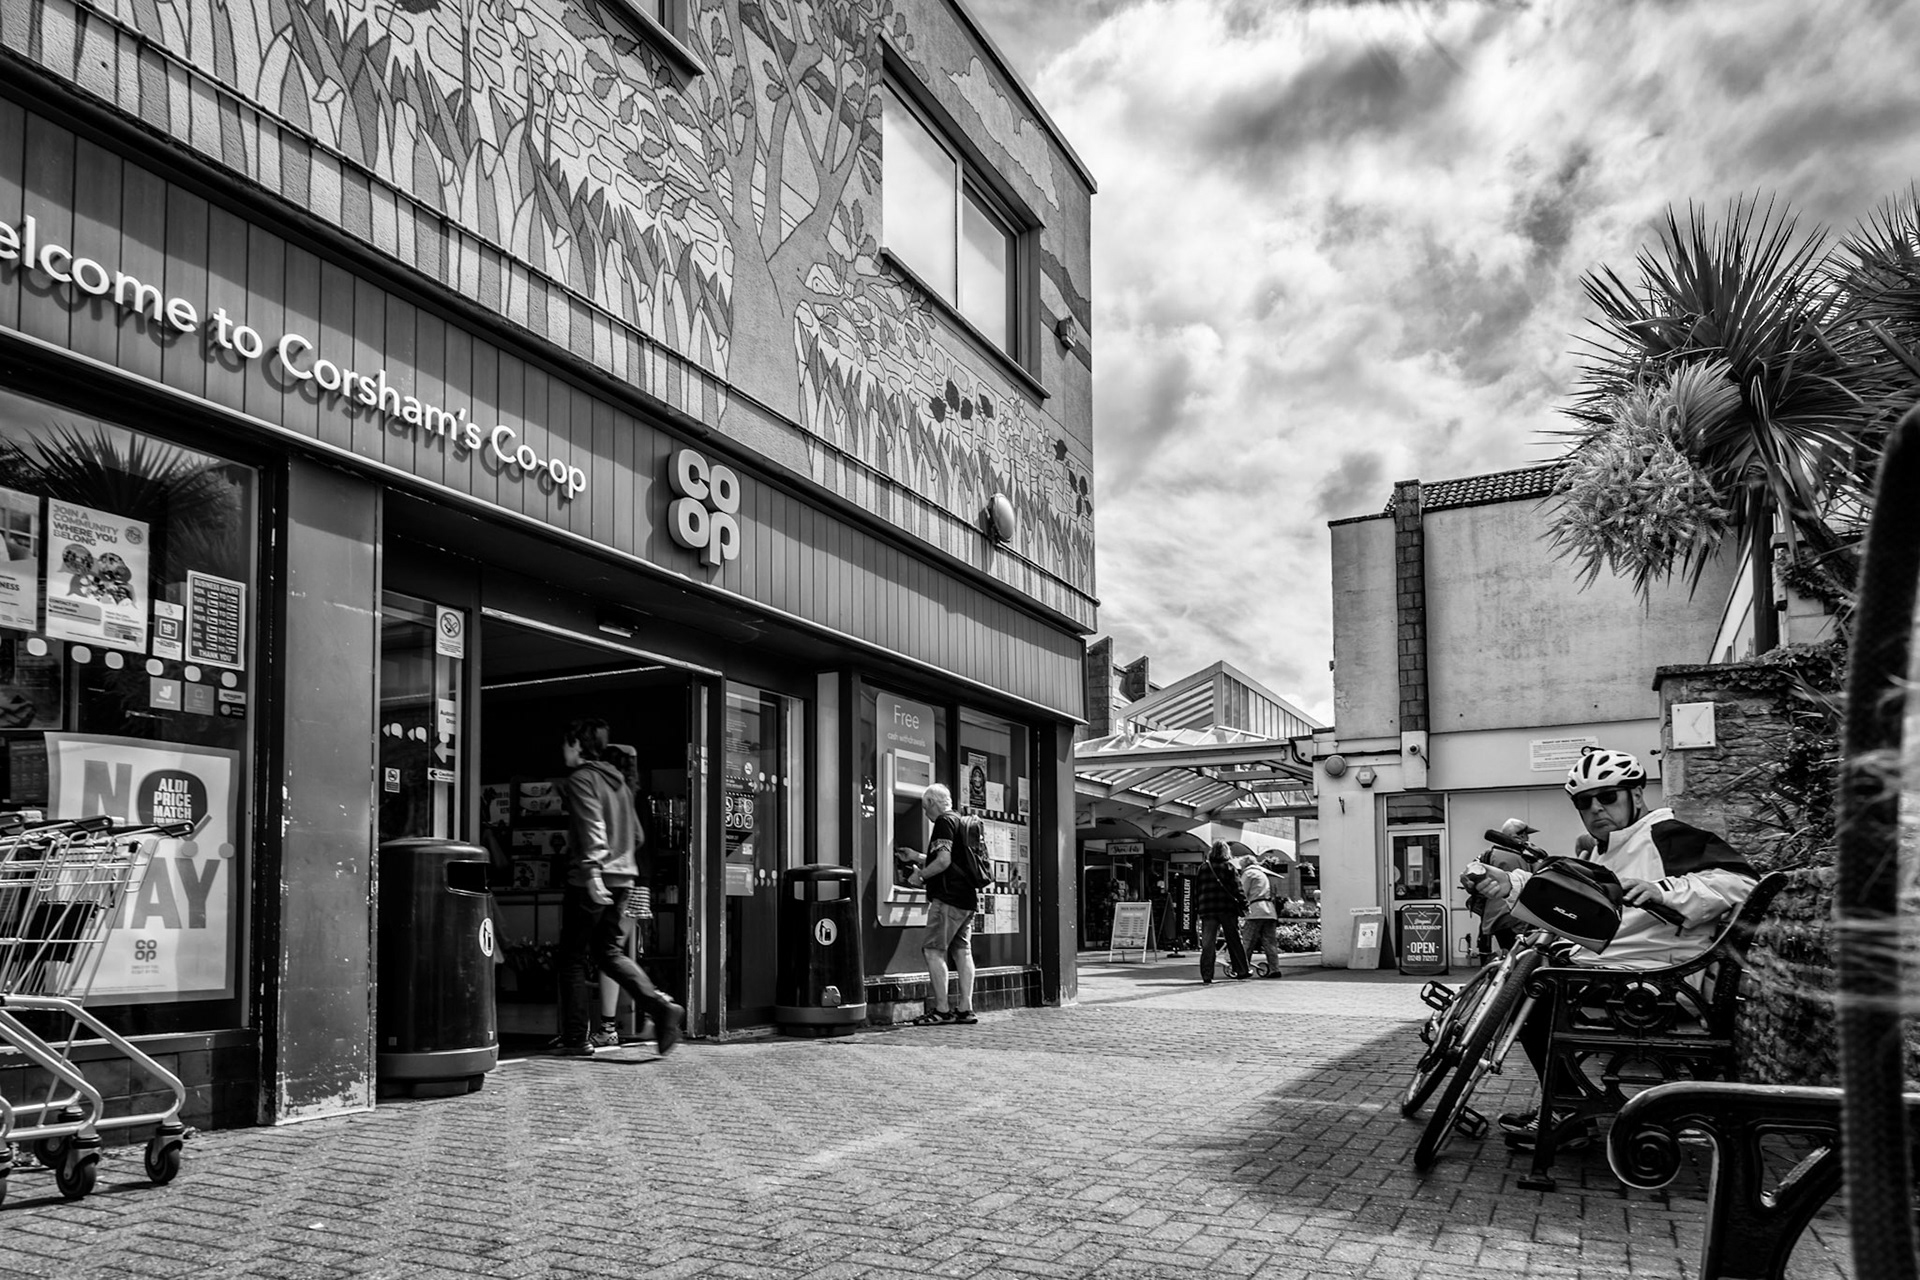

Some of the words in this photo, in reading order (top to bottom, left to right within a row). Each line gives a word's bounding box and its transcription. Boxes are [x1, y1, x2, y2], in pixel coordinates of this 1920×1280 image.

[213, 307, 263, 359] to
[277, 331, 482, 450] Corsham's
[491, 424, 587, 500] Co-op
[53, 504, 79, 517] JOIN
[81, 511, 89, 521] A
[53, 513, 119, 536] COMMUNITY
[53, 521, 94, 538] WHERE
[95, 532, 118, 544] YOU
[53, 529, 97, 547] BELONG
[194, 579, 220, 591] BUSINESS
[220, 584, 239, 596] HOURS
[198, 648, 219, 660] THANK
[219, 653, 232, 662] YOU
[894, 704, 919, 729] Free
[158, 777, 188, 794] ALDI
[153, 791, 192, 808] PRICE
[153, 805, 192, 820] MATCH
[1183, 878, 1191, 912] DISTILLERY
[1410, 941, 1435, 954] OPEN
